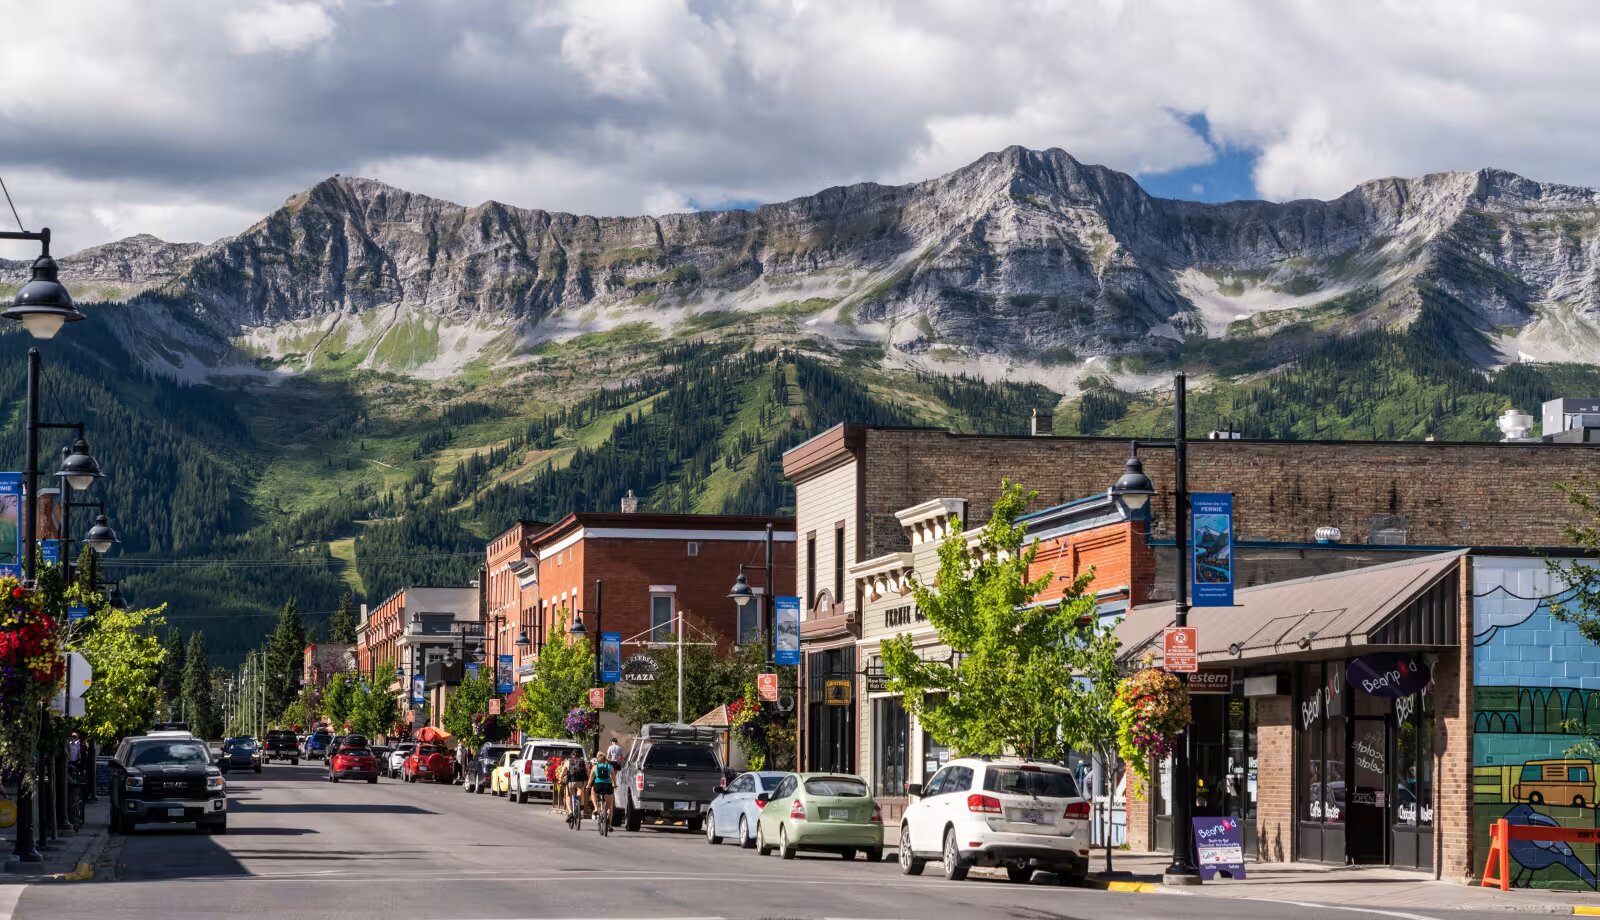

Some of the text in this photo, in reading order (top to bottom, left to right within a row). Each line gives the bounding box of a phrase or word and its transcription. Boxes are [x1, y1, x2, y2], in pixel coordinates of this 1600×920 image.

[625, 673, 655, 681] PLAZA
[1187, 673, 1228, 682] estern
[1198, 819, 1236, 838] Beanpod
